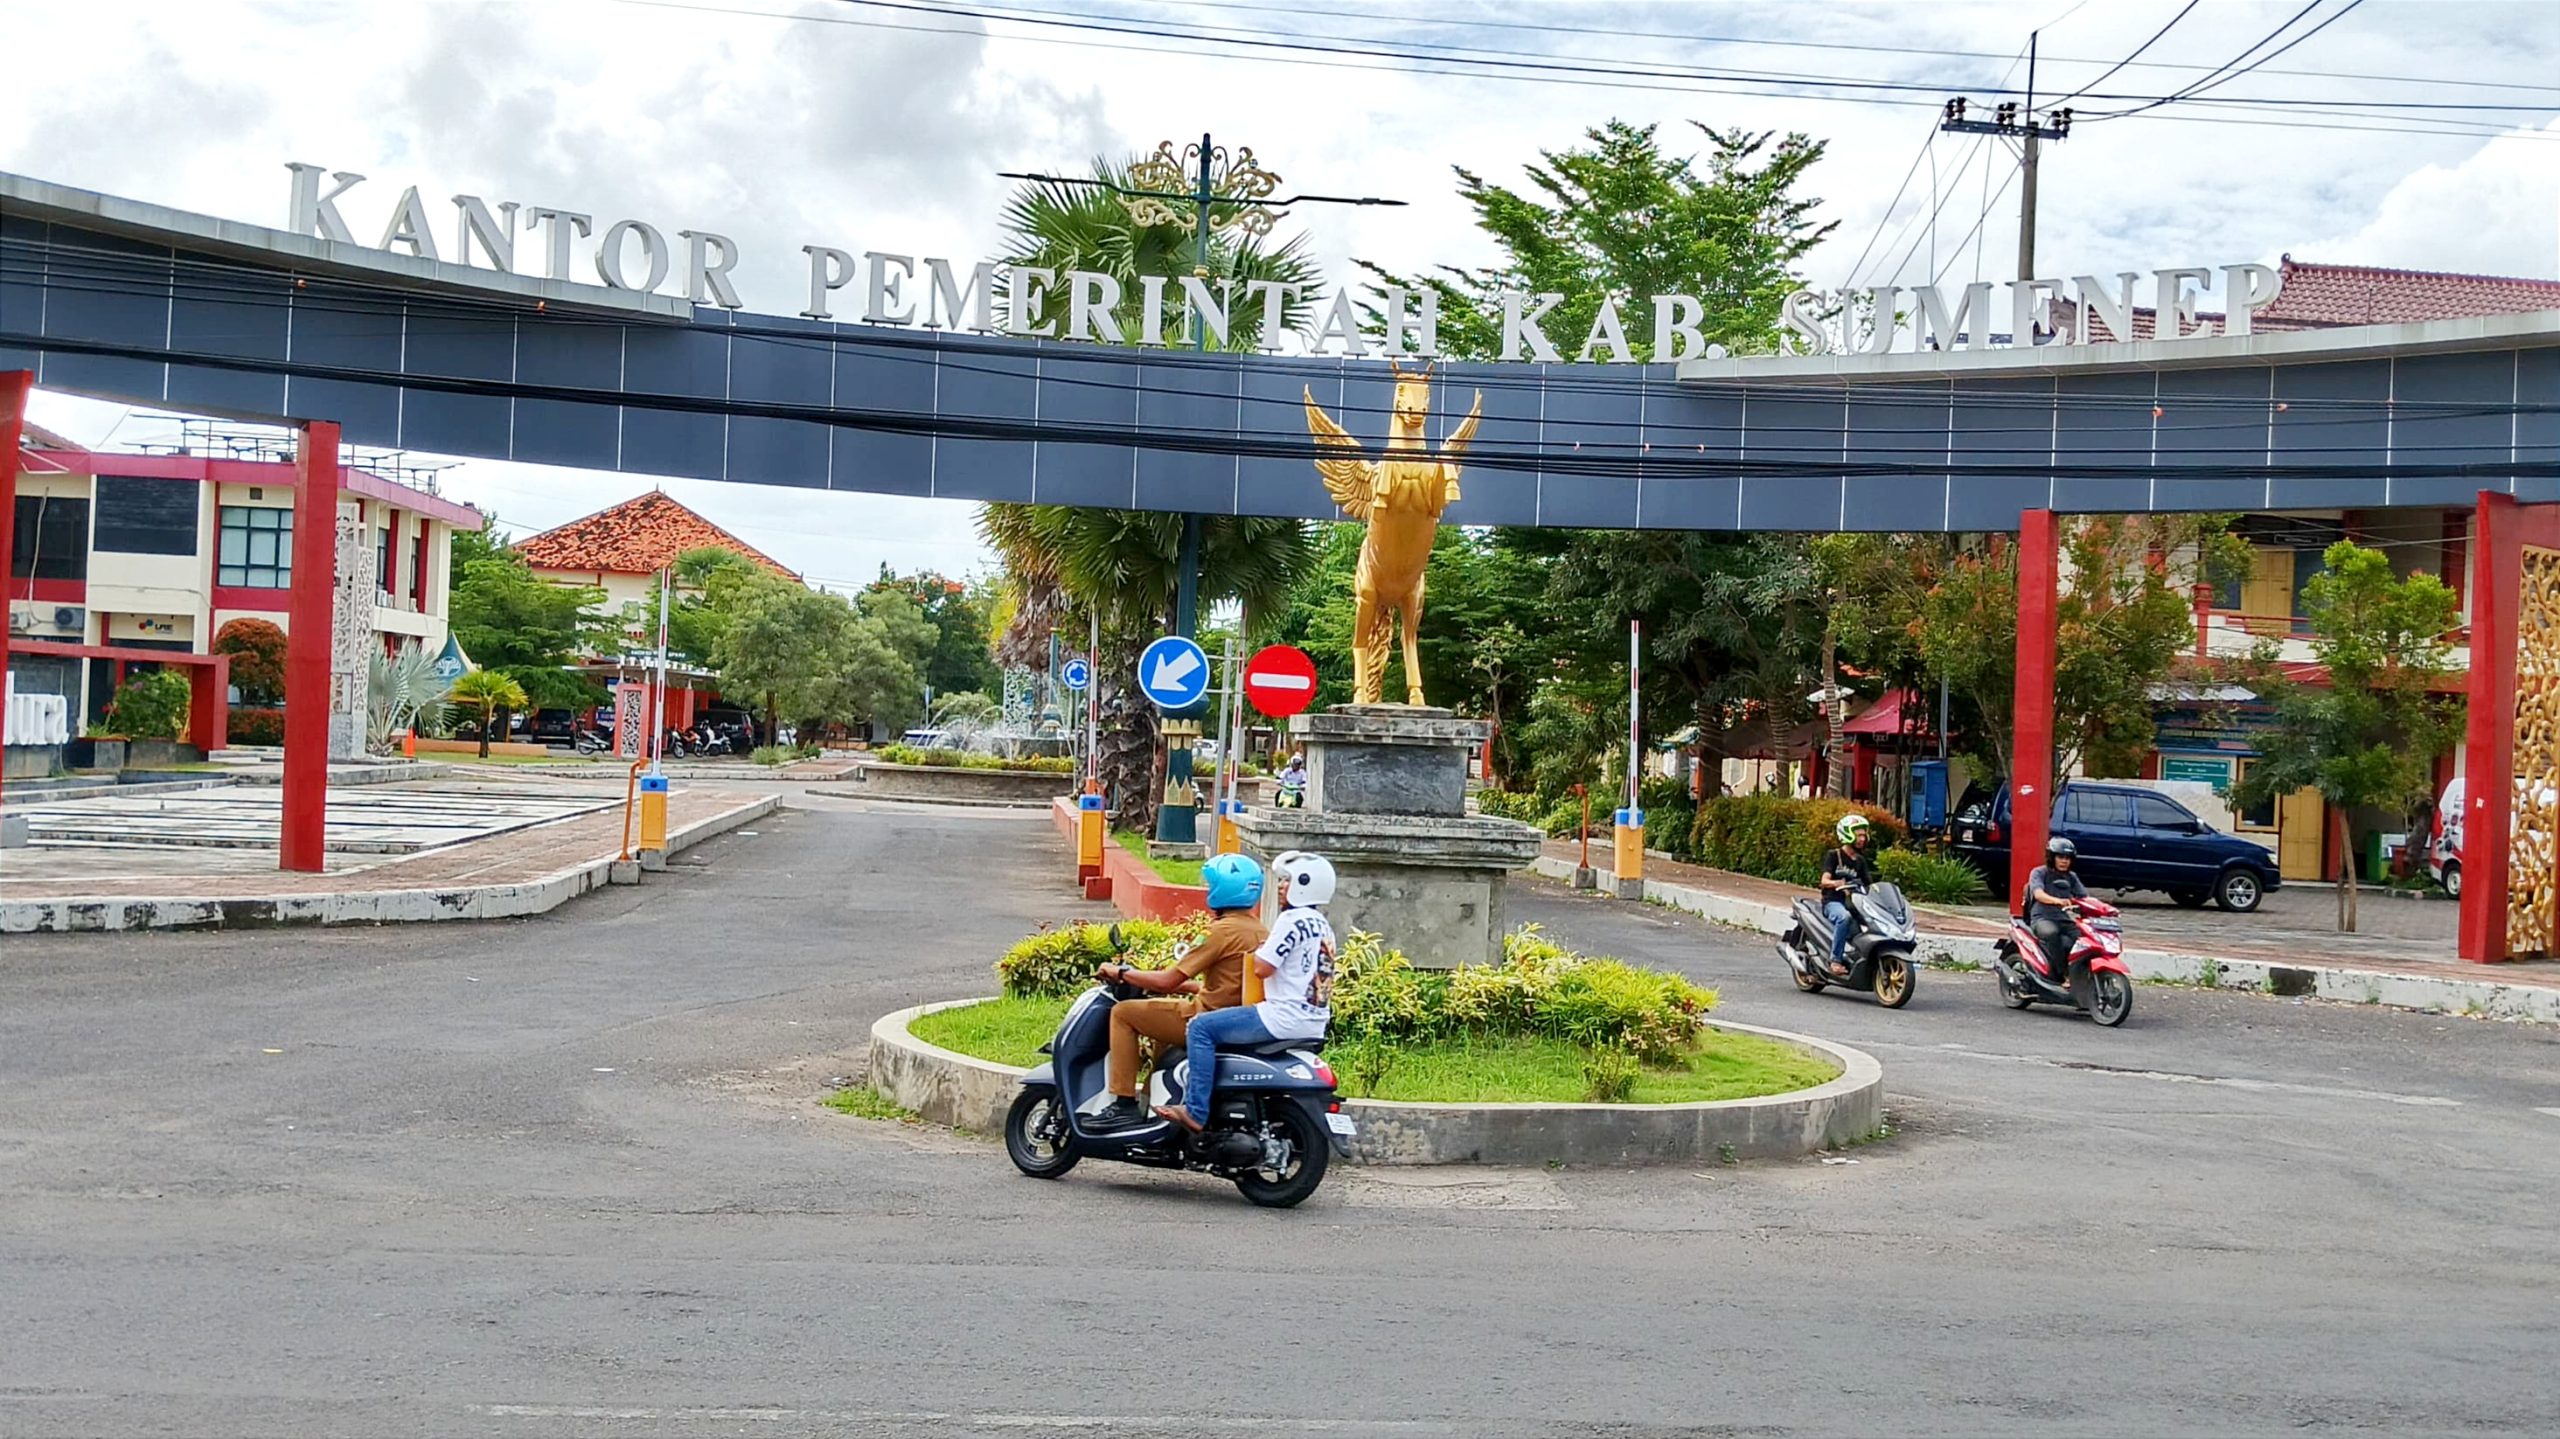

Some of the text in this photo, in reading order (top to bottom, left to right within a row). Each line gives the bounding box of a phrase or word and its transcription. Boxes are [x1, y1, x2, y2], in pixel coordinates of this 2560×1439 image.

[284, 162, 2284, 364] KANTOR PEMERINTAH KAB. SUMENEP
